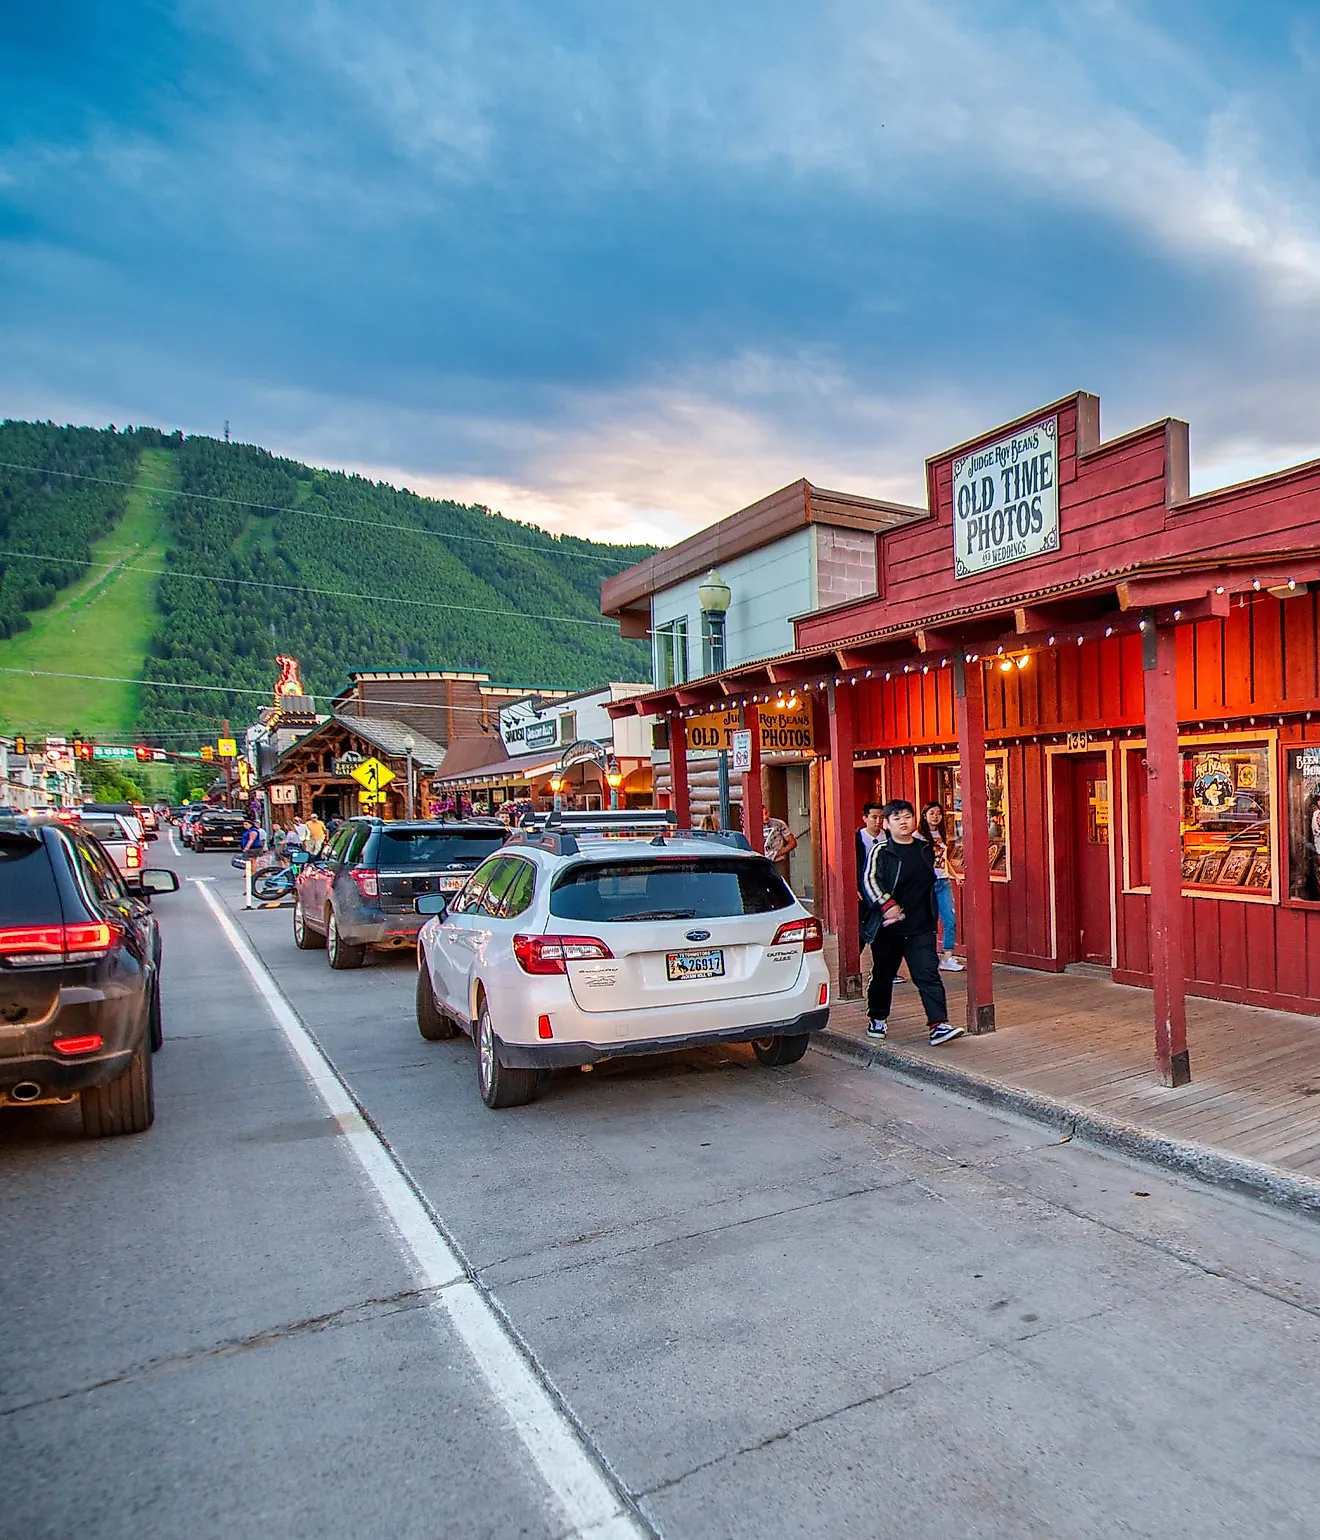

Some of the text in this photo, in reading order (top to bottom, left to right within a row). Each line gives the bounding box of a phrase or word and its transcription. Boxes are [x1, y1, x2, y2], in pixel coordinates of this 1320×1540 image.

[967, 451, 995, 479] JUDGE
[995, 443, 1011, 469] ROY
[957, 451, 1054, 520] OLD TIME
[966, 496, 1044, 556] PHOTOS
[992, 539, 1027, 564] WEDDINGS
[759, 713, 777, 728] ROY
[691, 727, 719, 746] OLD
[761, 728, 811, 747] PHOTOS
[1068, 732, 1086, 750] 135
[1295, 755, 1319, 770] BEEN
[688, 957, 720, 972] 26917
